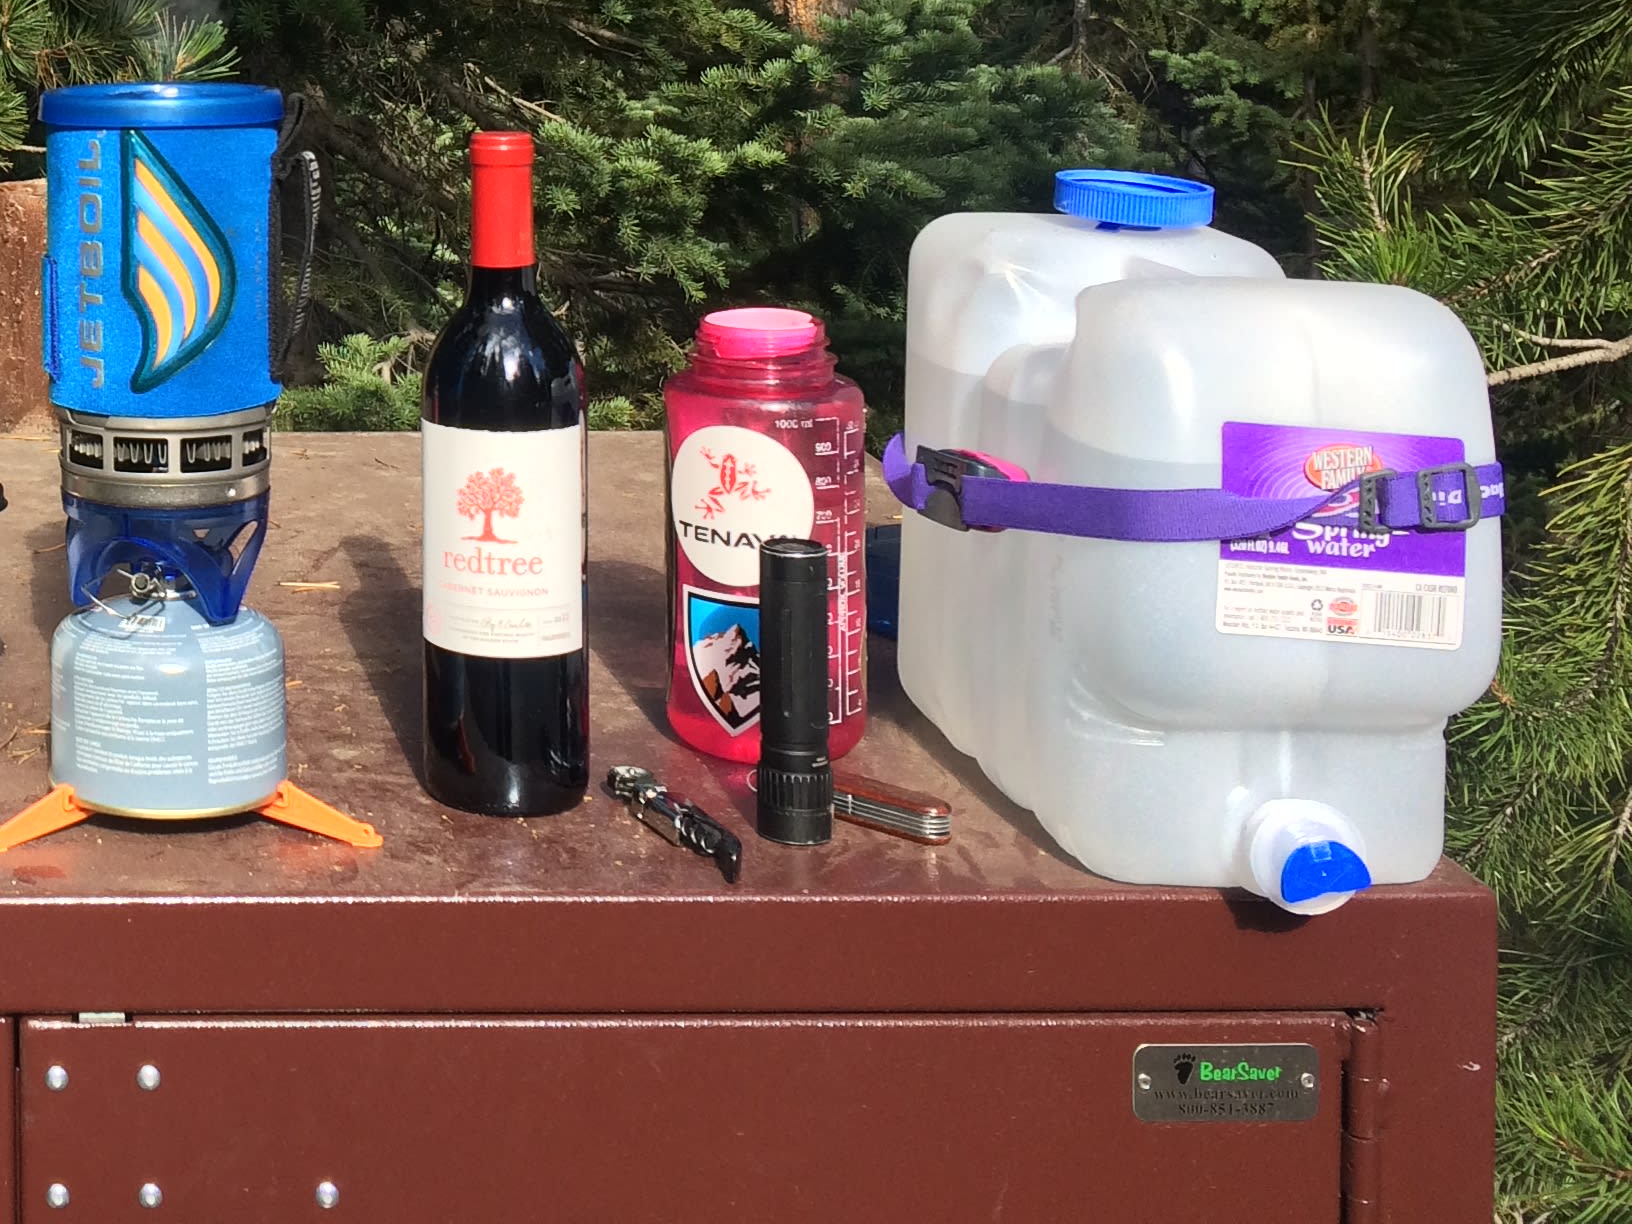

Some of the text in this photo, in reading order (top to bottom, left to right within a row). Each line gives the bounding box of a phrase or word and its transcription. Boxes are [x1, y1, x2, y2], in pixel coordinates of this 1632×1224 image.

[78, 139, 104, 389] JETBOIL
[1311, 445, 1374, 472] WESTERN
[1307, 537, 1376, 558] water
[442, 546, 544, 576] redtree
[1327, 625, 1355, 635] USA
[1199, 1061, 1283, 1082] BearSaver
[1154, 1087, 1299, 1101] www.bearsaver.com
